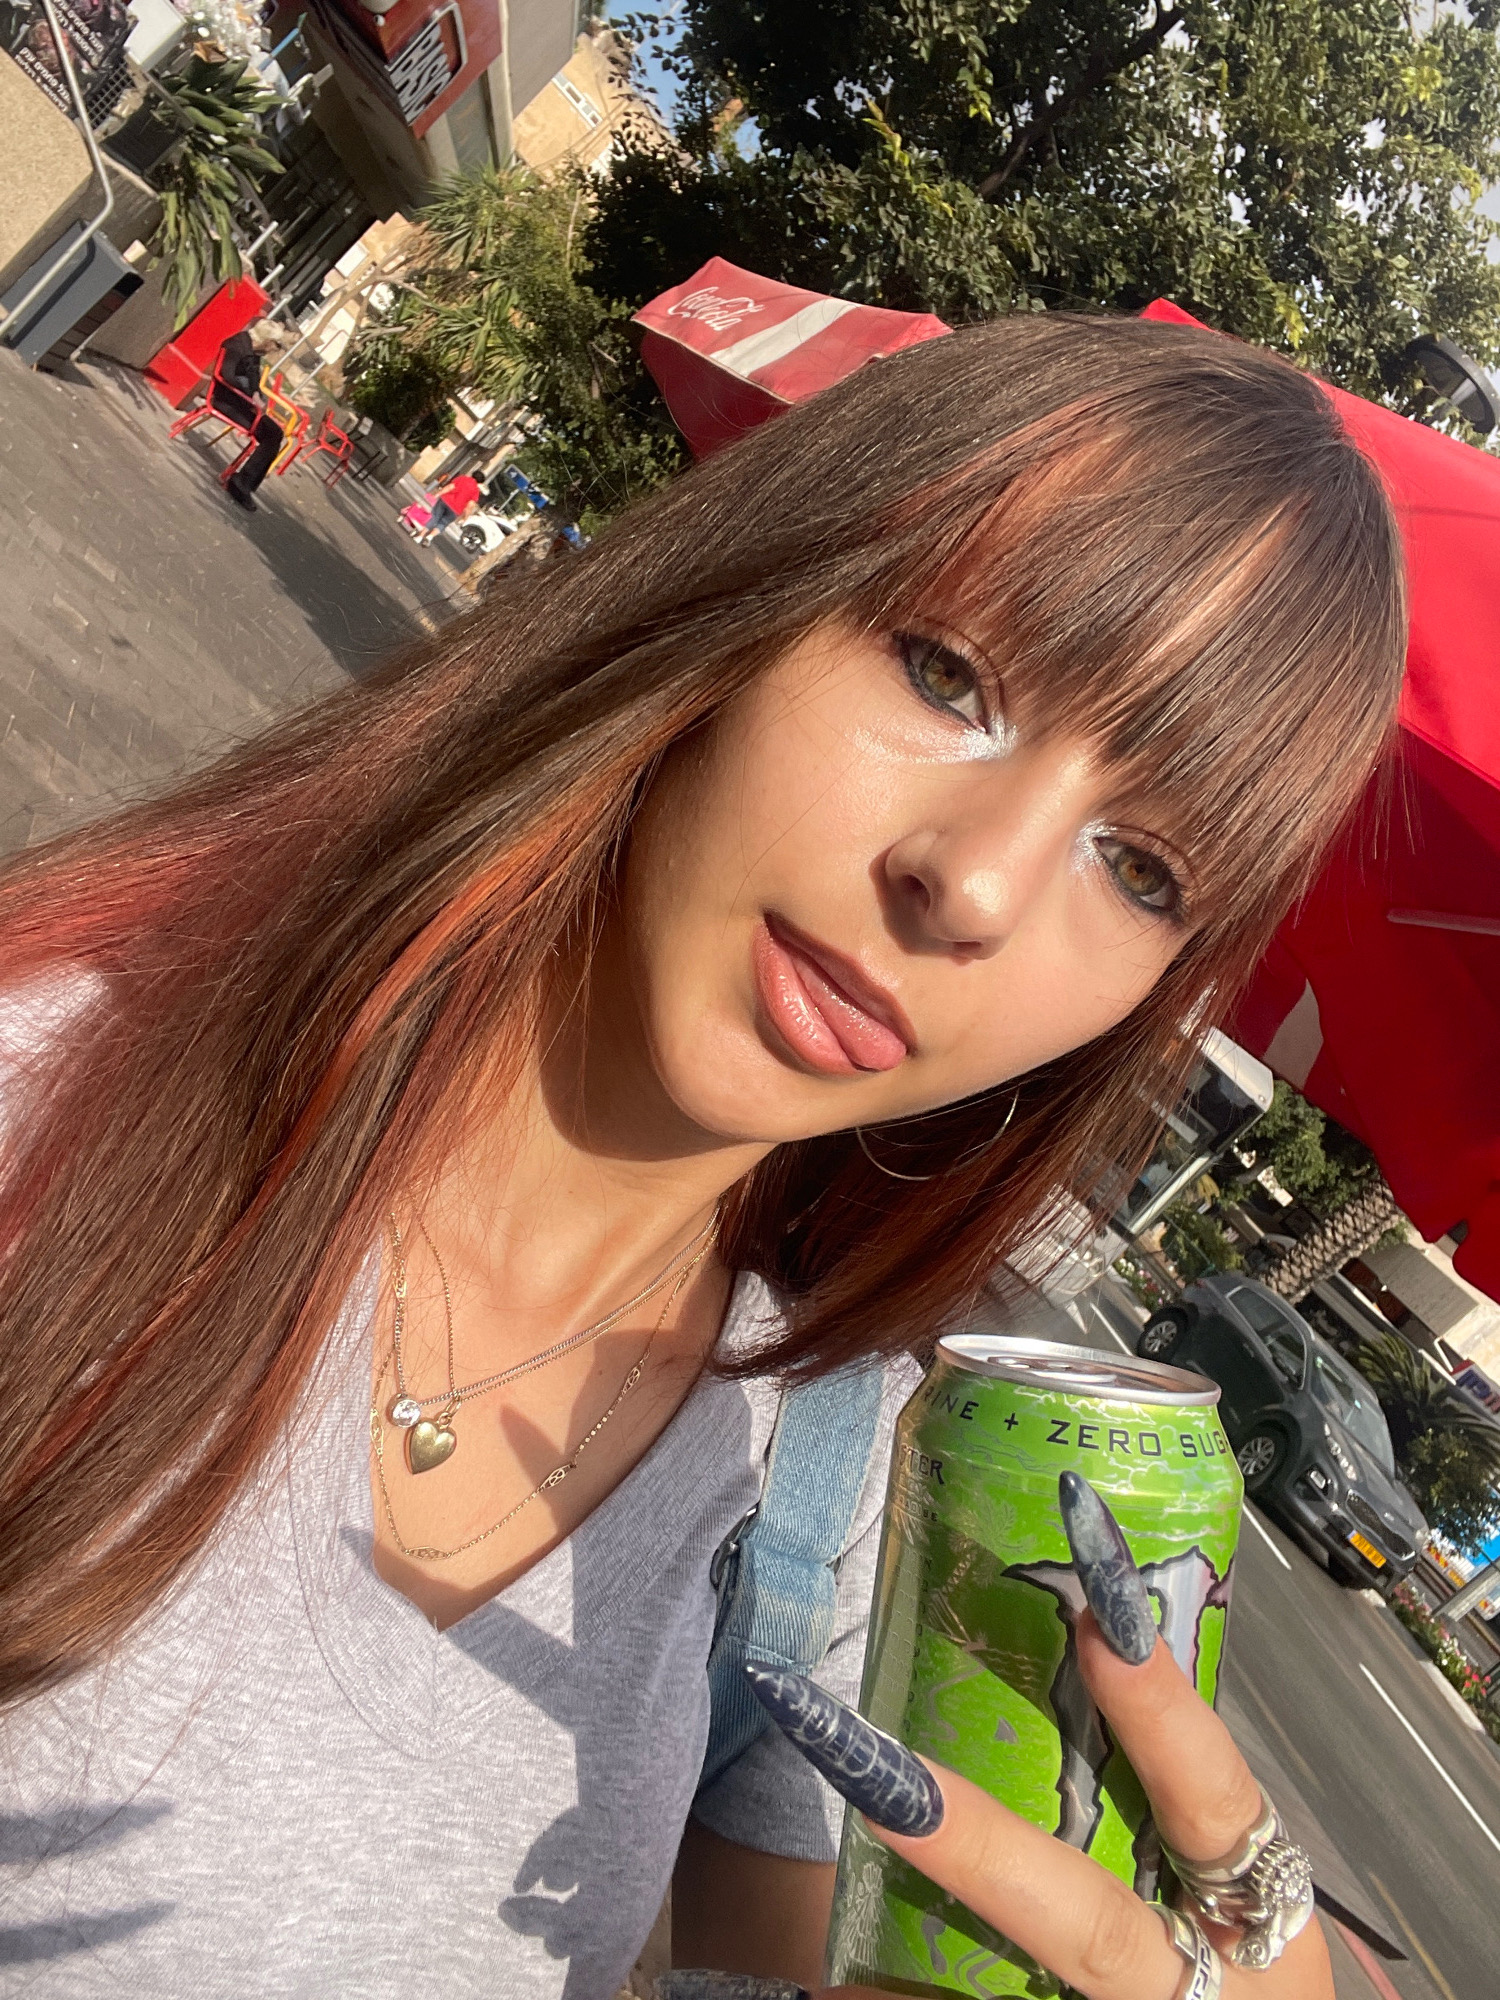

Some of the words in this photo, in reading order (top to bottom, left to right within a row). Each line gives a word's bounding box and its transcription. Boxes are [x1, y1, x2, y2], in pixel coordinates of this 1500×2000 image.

[389, 22, 453, 124] BASIC
[1045, 1418, 1162, 1457] ZERO
[1179, 1429, 1228, 1458] SUG
